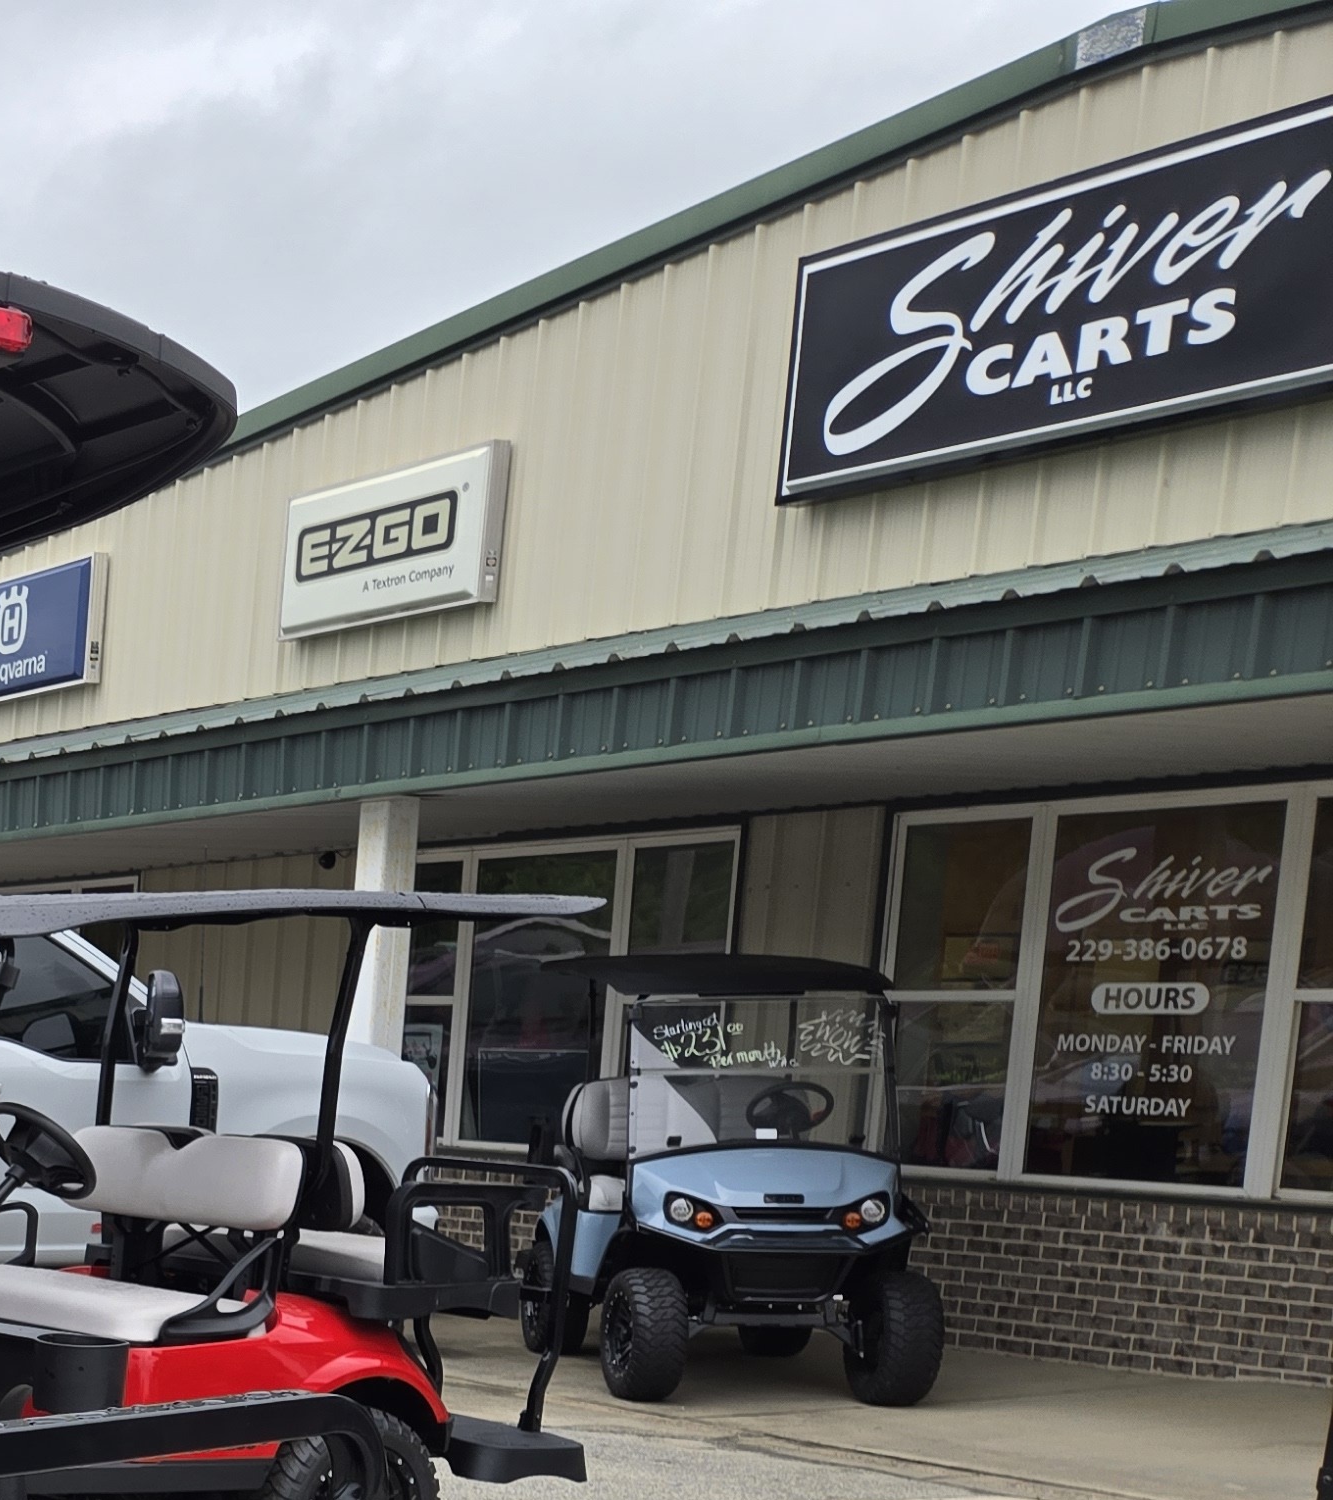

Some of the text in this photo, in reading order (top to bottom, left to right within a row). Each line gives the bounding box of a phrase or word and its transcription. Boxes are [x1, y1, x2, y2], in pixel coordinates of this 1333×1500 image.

[823, 169, 1332, 456] Shiver
[966, 288, 1236, 396] CARTS
[1049, 377, 1093, 405] LLC
[300, 497, 451, 577] EZGO
[362, 565, 455, 593] A Textron Company
[1055, 847, 1273, 933] Shiver
[1119, 904, 1262, 921] CARTS
[1065, 936, 1248, 962] 229-386-0678
[1102, 987, 1196, 1010] HOURS
[1056, 1033, 1147, 1055] MONDAY
[1161, 1035, 1236, 1056] FRIDAY
[1090, 1063, 1133, 1082] 8:30
[1148, 1064, 1193, 1084] 5:30
[1084, 1095, 1192, 1117] SATURDAY
